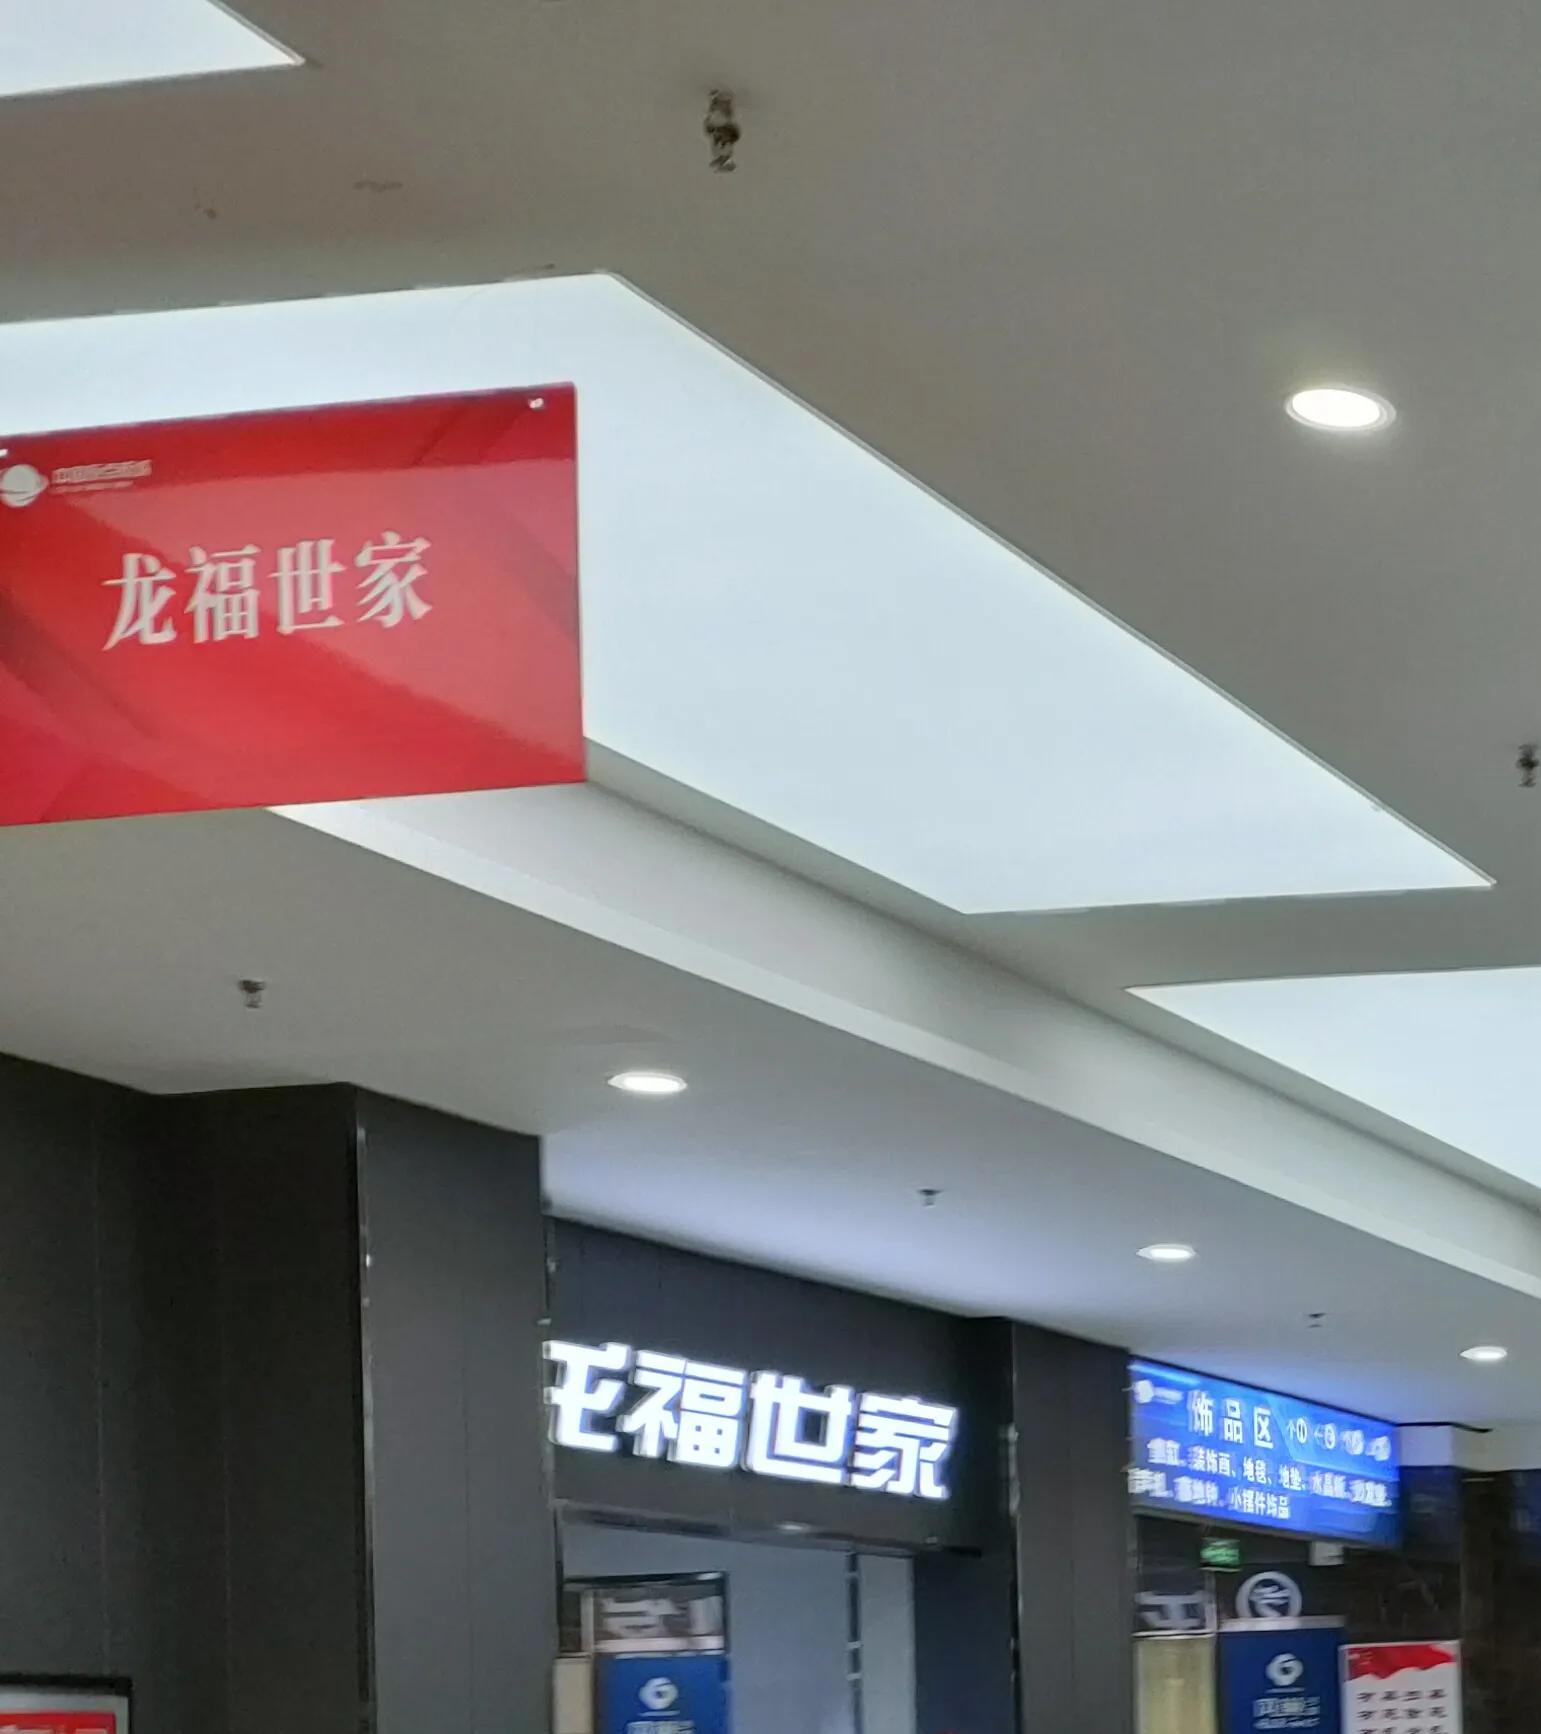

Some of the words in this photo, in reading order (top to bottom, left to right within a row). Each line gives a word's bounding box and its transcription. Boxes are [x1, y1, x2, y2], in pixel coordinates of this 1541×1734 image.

[102, 530, 433, 651] 龙福世家
[543, 1339, 958, 1500] 龙福世家
[1187, 1389, 1275, 1449] 饰品区
